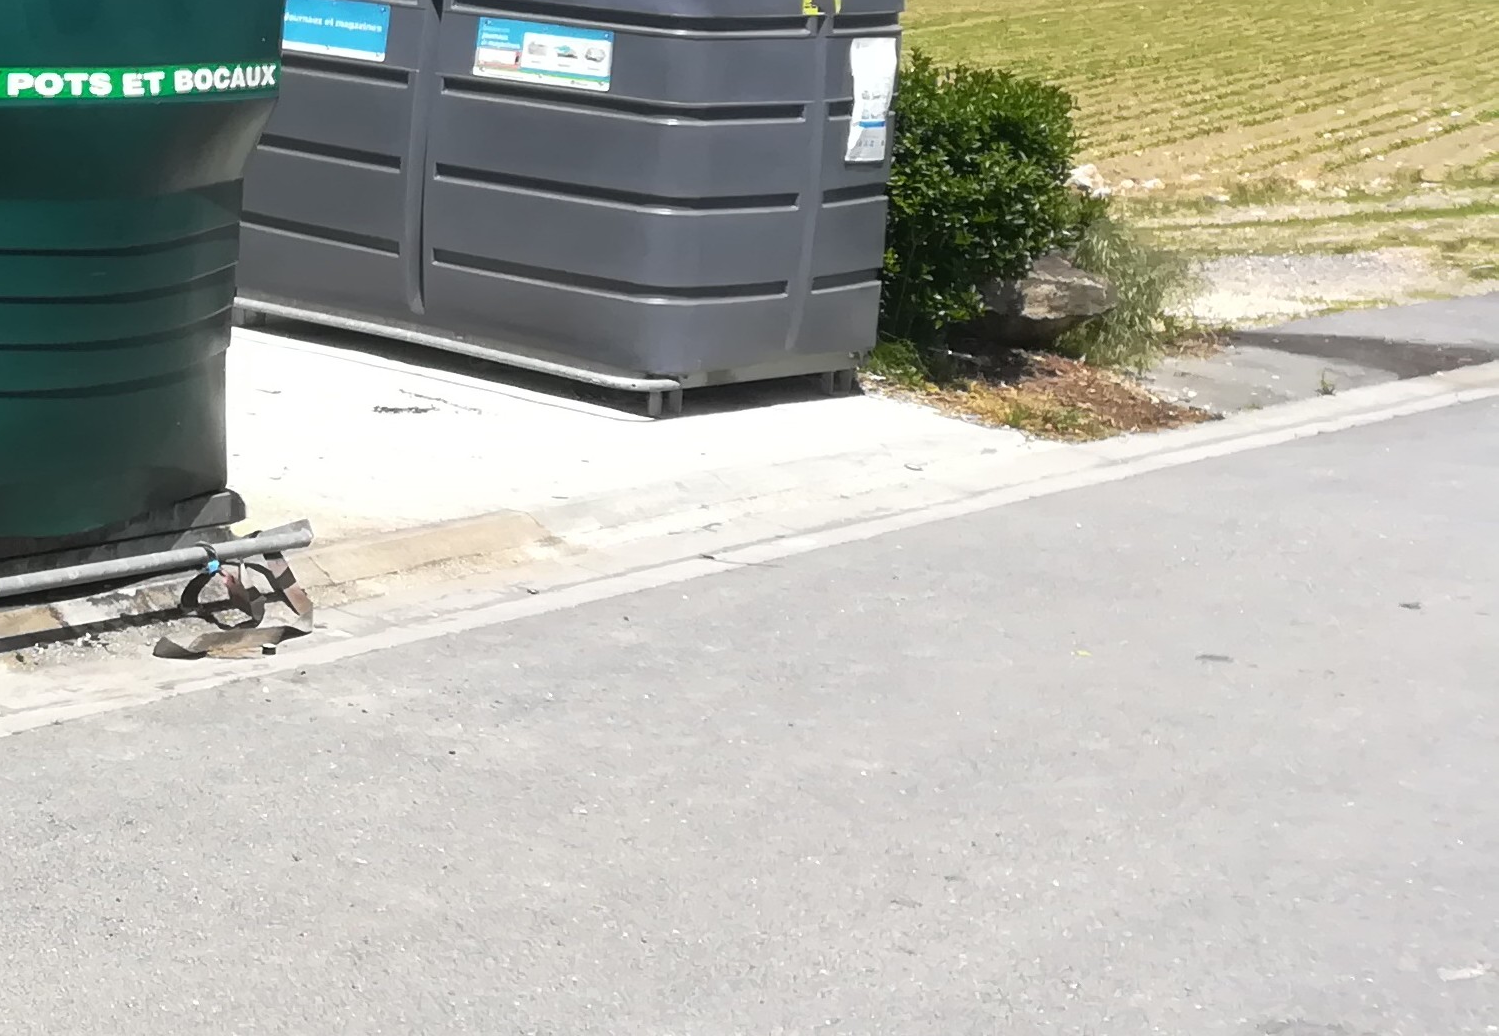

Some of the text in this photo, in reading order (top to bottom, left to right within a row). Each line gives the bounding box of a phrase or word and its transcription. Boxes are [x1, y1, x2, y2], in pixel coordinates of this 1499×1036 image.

[7, 71, 113, 96] POTS
[122, 72, 165, 96] ET
[174, 64, 277, 93] BOCAUX
